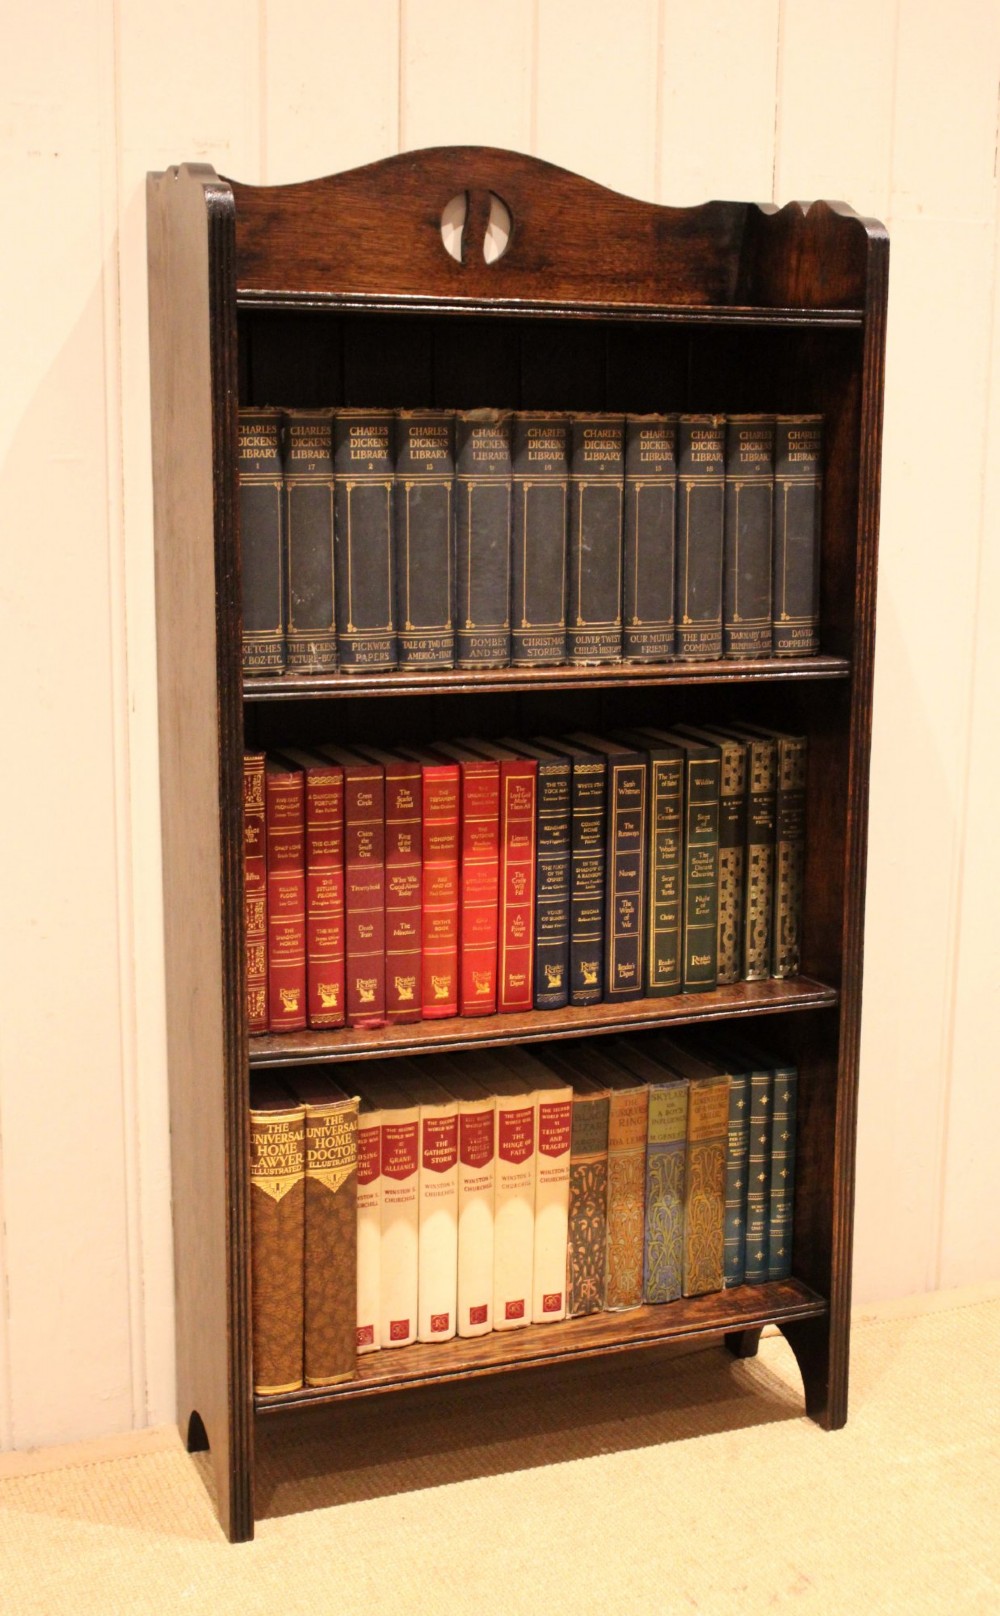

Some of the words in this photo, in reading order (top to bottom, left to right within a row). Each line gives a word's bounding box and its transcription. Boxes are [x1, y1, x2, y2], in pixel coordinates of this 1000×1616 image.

[290, 427, 331, 435] CHARLES
[350, 427, 388, 436] CHARLES
[409, 427, 448, 435] CHARLES
[528, 429, 565, 437] CHARLES
[584, 429, 621, 437] CHARLES
[291, 438, 331, 447] DICKENS
[350, 438, 388, 447] DICKENS
[410, 439, 448, 447] DICKENS
[528, 440, 565, 448] DICKENS
[585, 441, 621, 449] DICKENS
[692, 442, 722, 450] DICKEN
[291, 450, 331, 459] LIBRARY
[351, 450, 388, 459] LIBRARY
[410, 450, 448, 459] LIBRARY
[529, 452, 565, 460] LIBRARY
[584, 452, 621, 460] LIBRARY
[641, 453, 672, 461] LIBRARY
[471, 638, 506, 647] DOMBEY
[522, 637, 564, 646] CHRISTMAS
[576, 636, 600, 644] OLIVER
[601, 635, 621, 643] TWIST
[630, 635, 647, 643] OUR
[242, 644, 281, 653] KETCHES
[289, 644, 305, 652] THE
[352, 641, 391, 651] PICKWICK
[403, 641, 417, 649] TALE
[429, 640, 439, 648] TWO
[642, 645, 668, 653] FRIEND
[527, 648, 561, 656] STORIES
[356, 653, 389, 662] PAPERS
[652, 1091, 686, 1101] SKYLAR
[324, 1115, 344, 1125] THE
[619, 1117, 643, 1127] RING
[267, 1123, 289, 1133] THE
[307, 1121, 357, 1137] UNIVERSAL
[542, 1127, 569, 1135] TRIUMPH
[315, 1133, 352, 1148] HOME
[258, 1143, 297, 1156] HOME
[308, 1143, 356, 1160] DOCTOR
[424, 1147, 456, 1155] GATHERING
[309, 1155, 356, 1167] ILLUSTRATED
[431, 1156, 452, 1164] STORM
[252, 1165, 302, 1175] ILLUSTRATED
